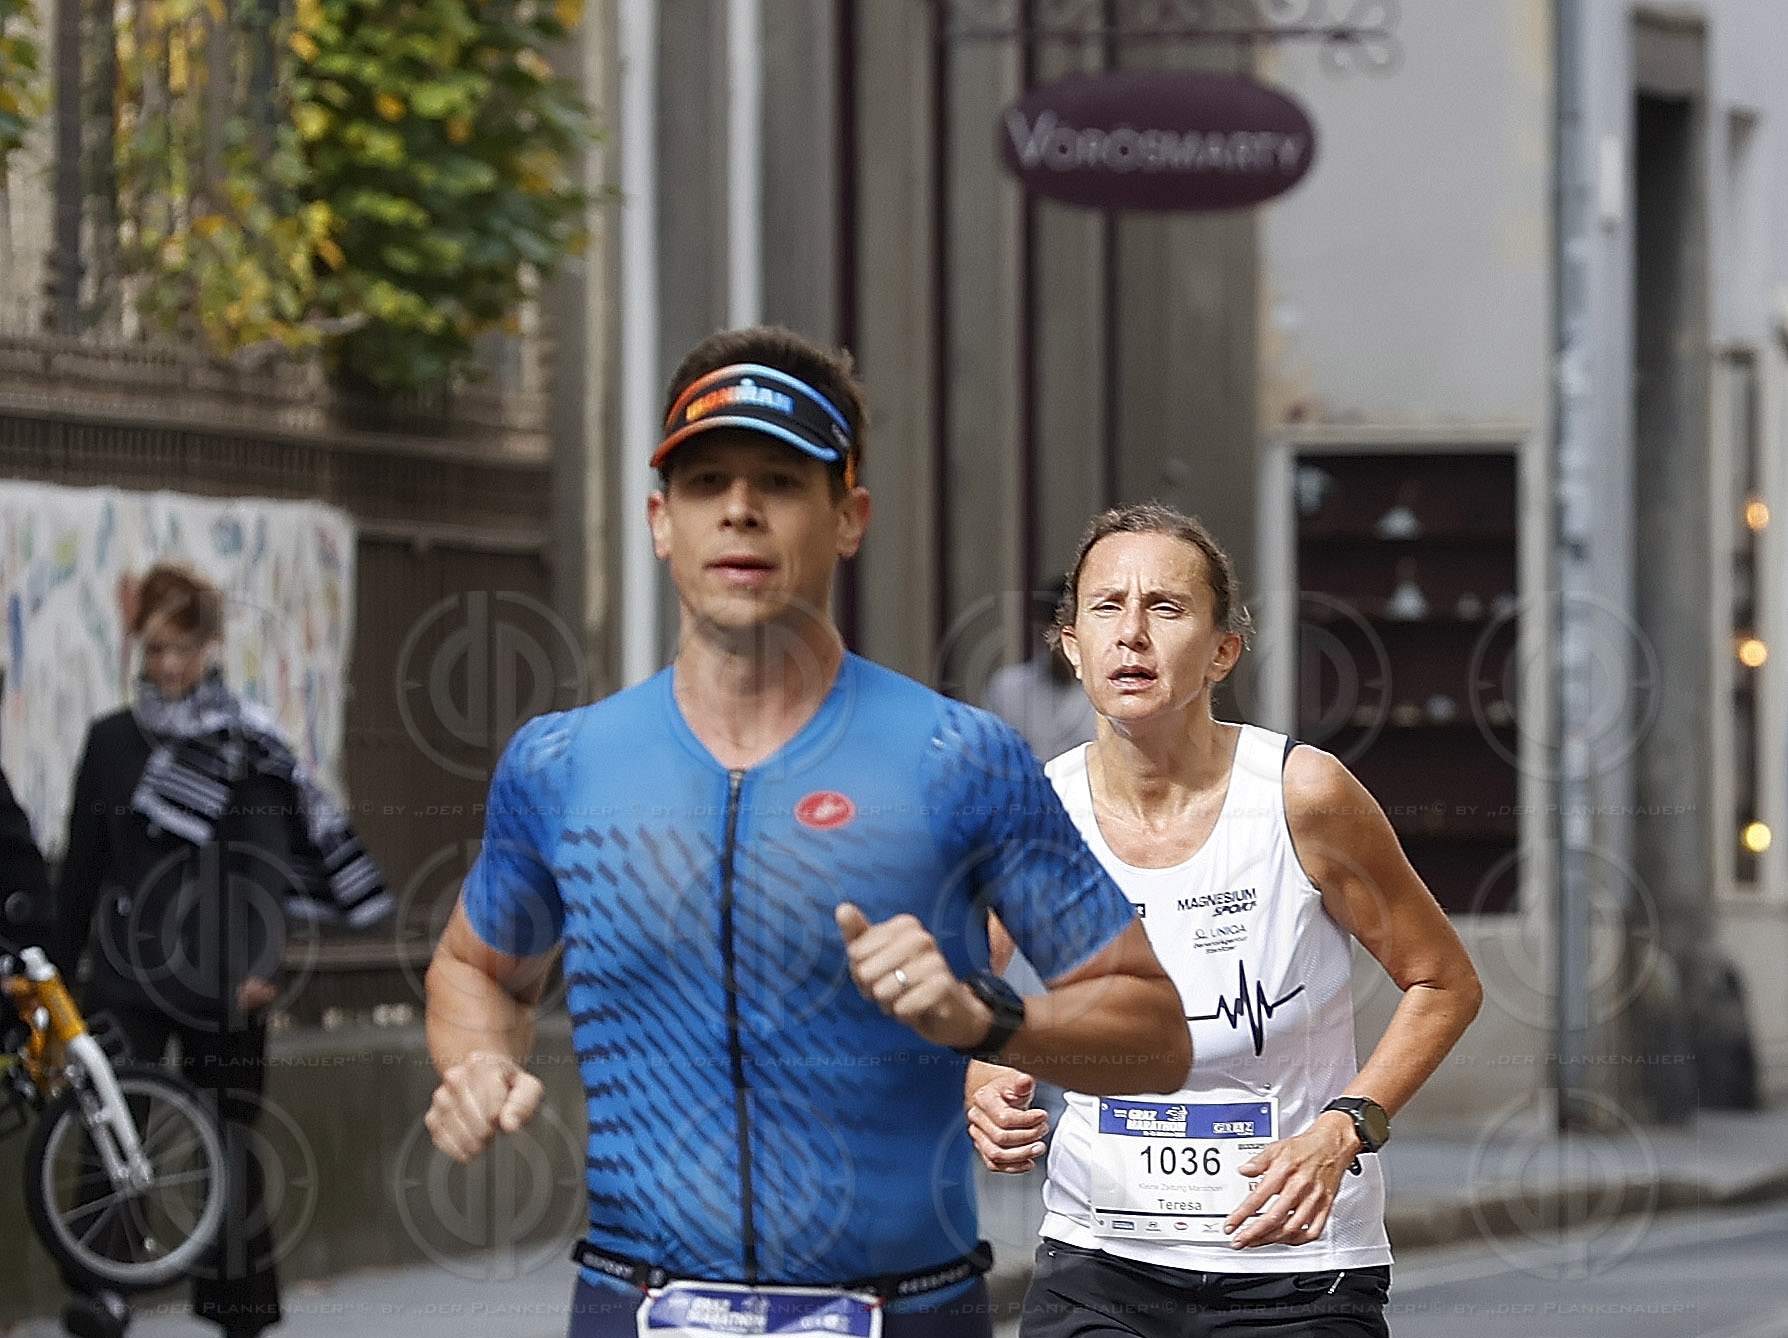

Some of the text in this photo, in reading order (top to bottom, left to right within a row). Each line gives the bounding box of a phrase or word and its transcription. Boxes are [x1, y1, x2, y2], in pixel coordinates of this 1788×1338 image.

[1177, 888, 1257, 911] MAGNESIUM
[1140, 1145, 1221, 1176] 1036
[1157, 1199, 1202, 1211] Teresa
